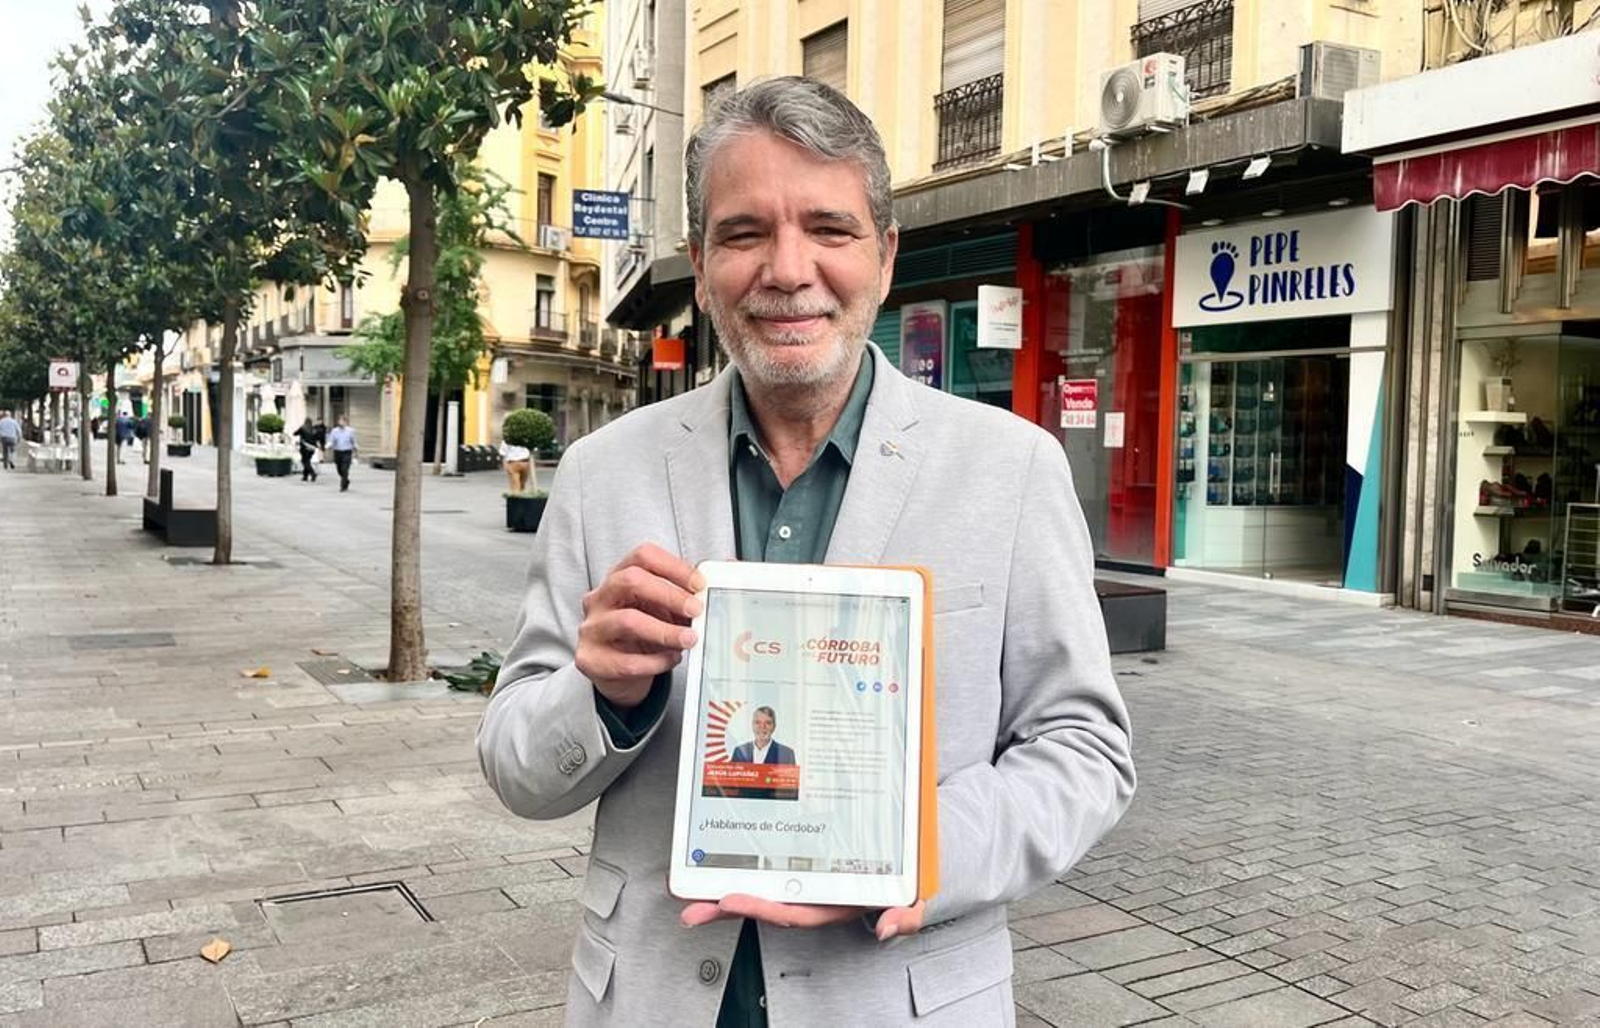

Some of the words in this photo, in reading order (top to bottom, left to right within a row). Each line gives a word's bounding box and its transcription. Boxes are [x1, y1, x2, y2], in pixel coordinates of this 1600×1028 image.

[1250, 230, 1300, 267] PEPE
[1249, 263, 1355, 305] PINRELES
[1064, 397, 1095, 409] Vende
[753, 641, 782, 655] CS
[806, 637, 881, 653] CÓRDOBA
[817, 652, 880, 665] FUTURO
[699, 818, 757, 831] ¿Hablamos
[760, 821, 773, 831] de
